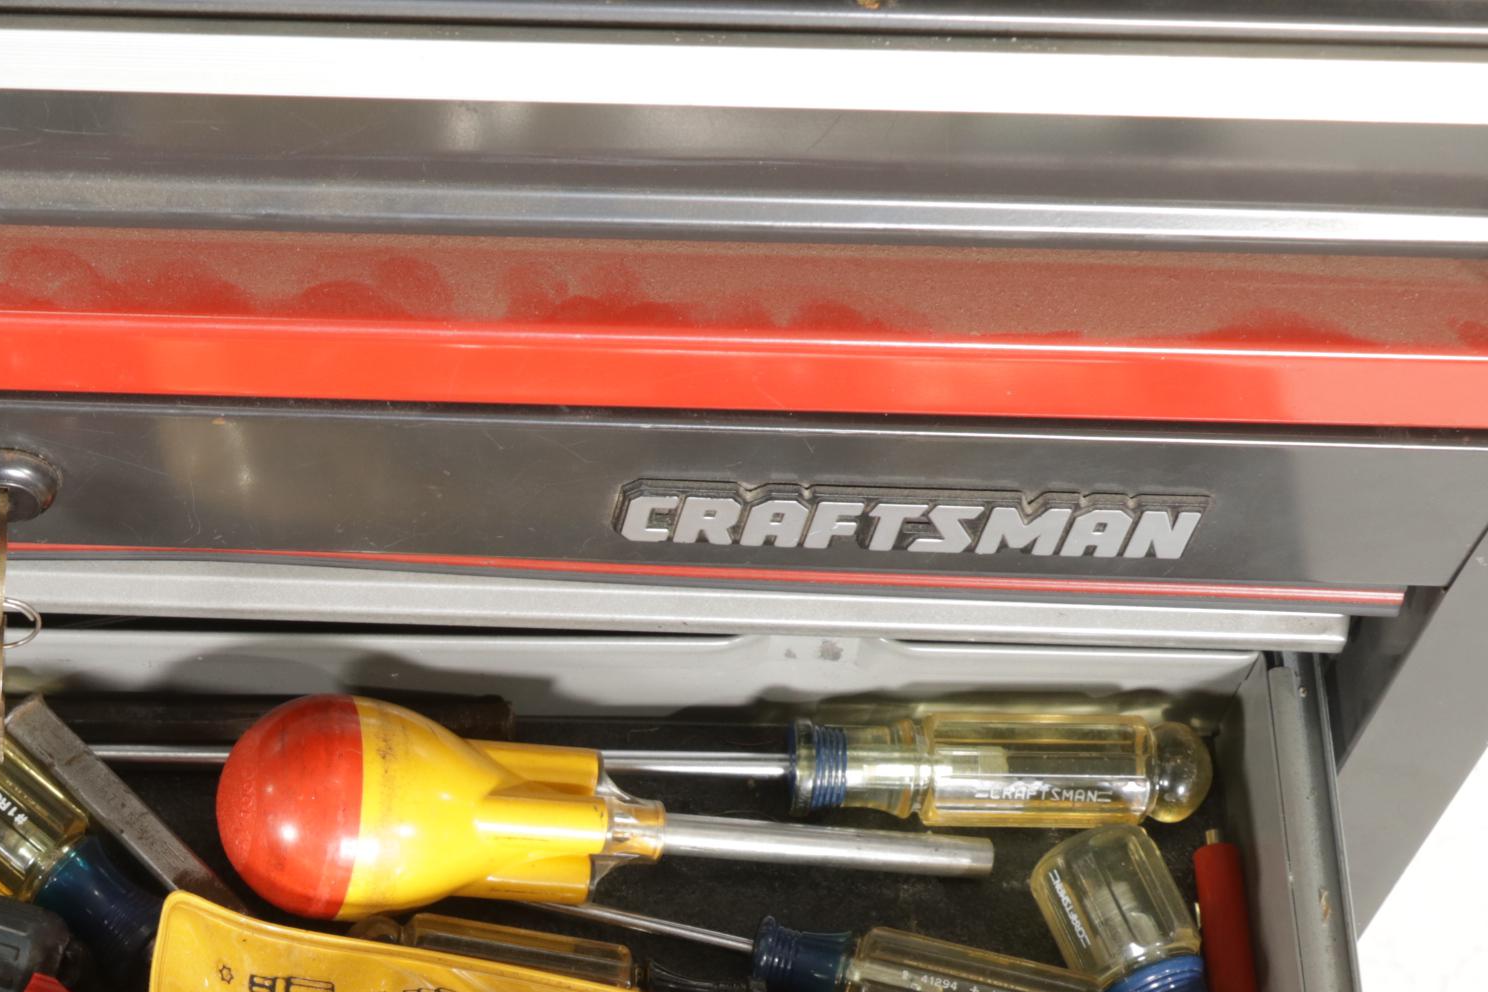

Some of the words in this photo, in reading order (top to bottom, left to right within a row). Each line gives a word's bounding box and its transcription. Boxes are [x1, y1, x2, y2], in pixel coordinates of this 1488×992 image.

[617, 494, 1204, 561] CRAFTSMAN
[7, 806, 29, 826] #1
[920, 975, 959, 992] 41294
